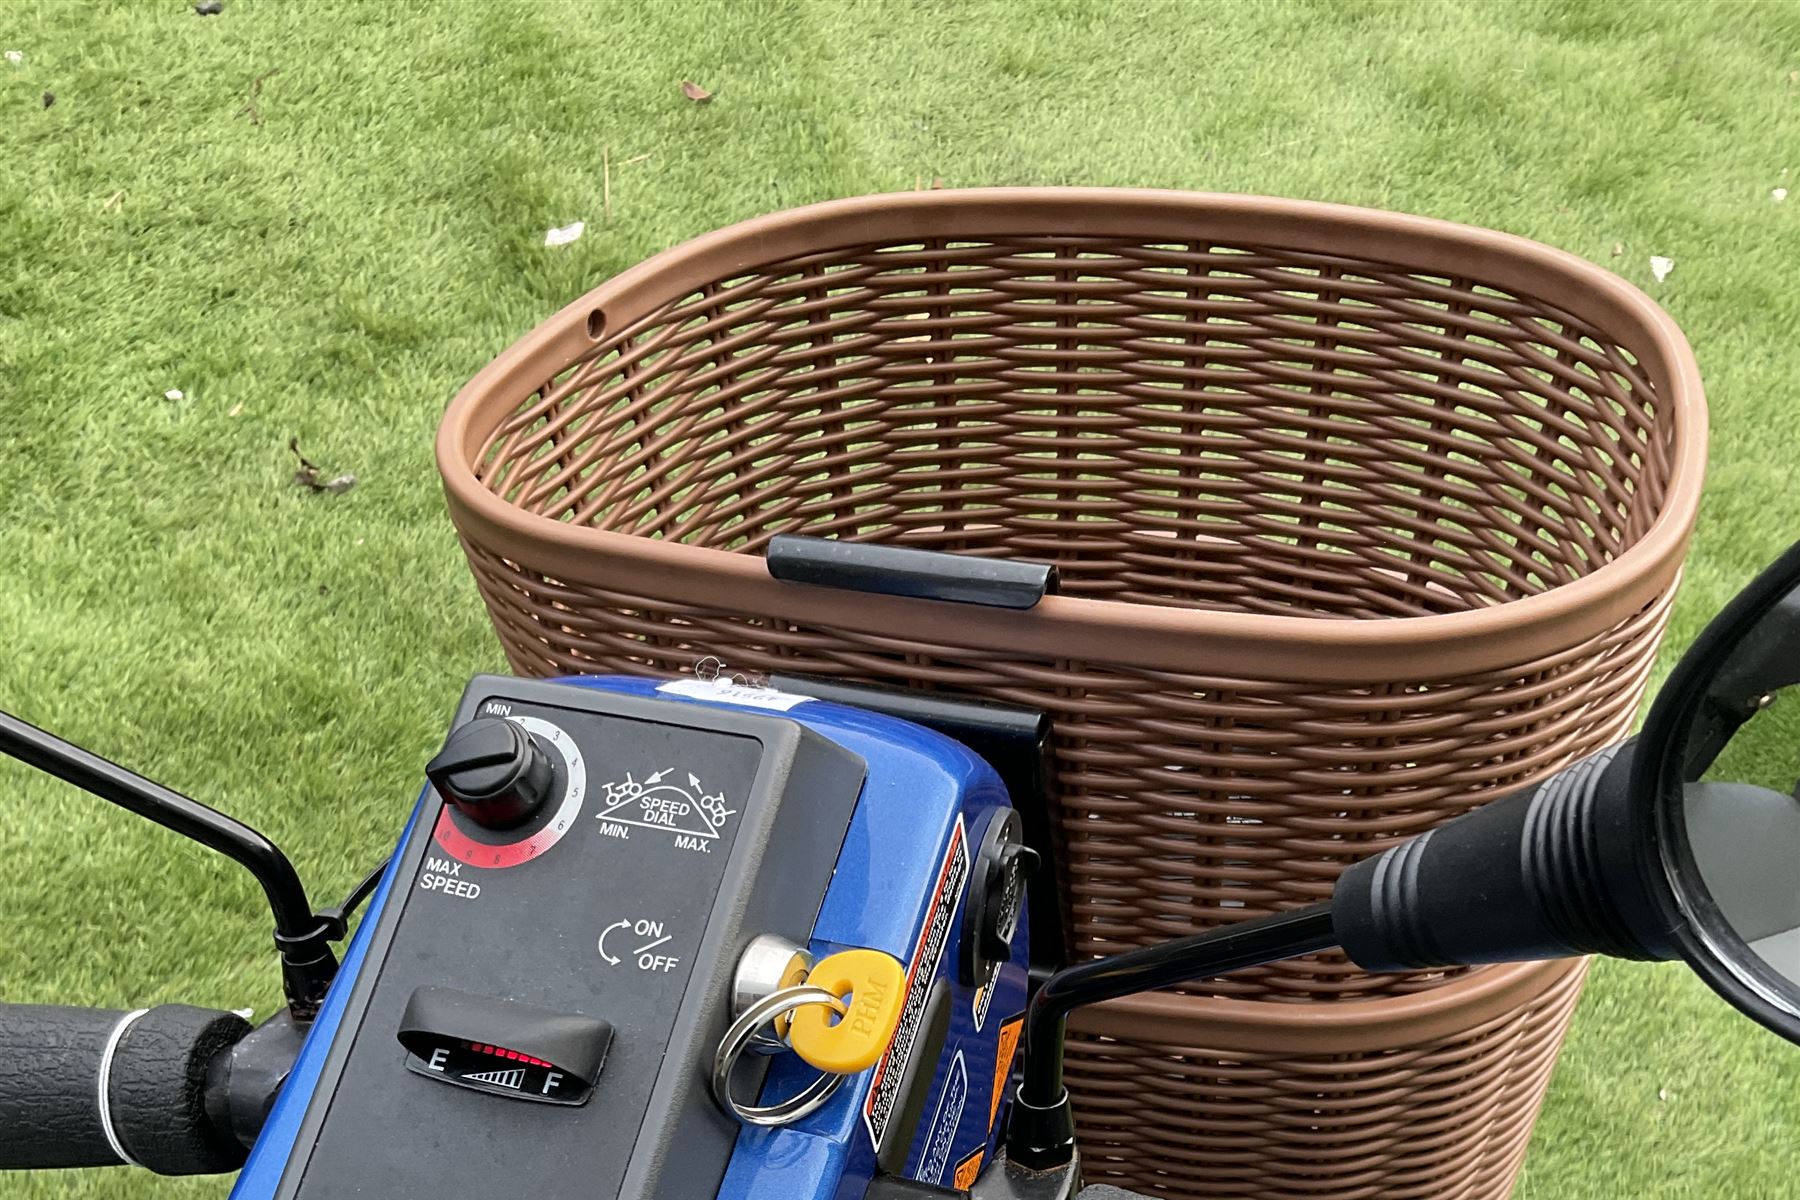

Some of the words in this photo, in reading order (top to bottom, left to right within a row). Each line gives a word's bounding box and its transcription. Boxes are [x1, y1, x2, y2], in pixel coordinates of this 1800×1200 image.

[486, 703, 511, 716] MIN
[552, 730, 561, 741] 3
[570, 758, 578, 767] 4
[571, 787, 579, 797] 5
[639, 796, 690, 816] SPEED
[557, 820, 566, 830] 6
[643, 809, 677, 827] DIAL
[438, 829, 449, 840] 10
[599, 822, 630, 839] MIN.
[529, 845, 537, 855] 7
[674, 835, 711, 853] MAX.
[465, 850, 473, 860] 9
[493, 854, 501, 865] 8
[426, 857, 462, 876] MAX
[420, 873, 481, 900] SPEED
[634, 919, 664, 938] ON
[638, 953, 680, 973] OFF
[428, 1048, 450, 1072] E
[541, 1071, 563, 1094] F
